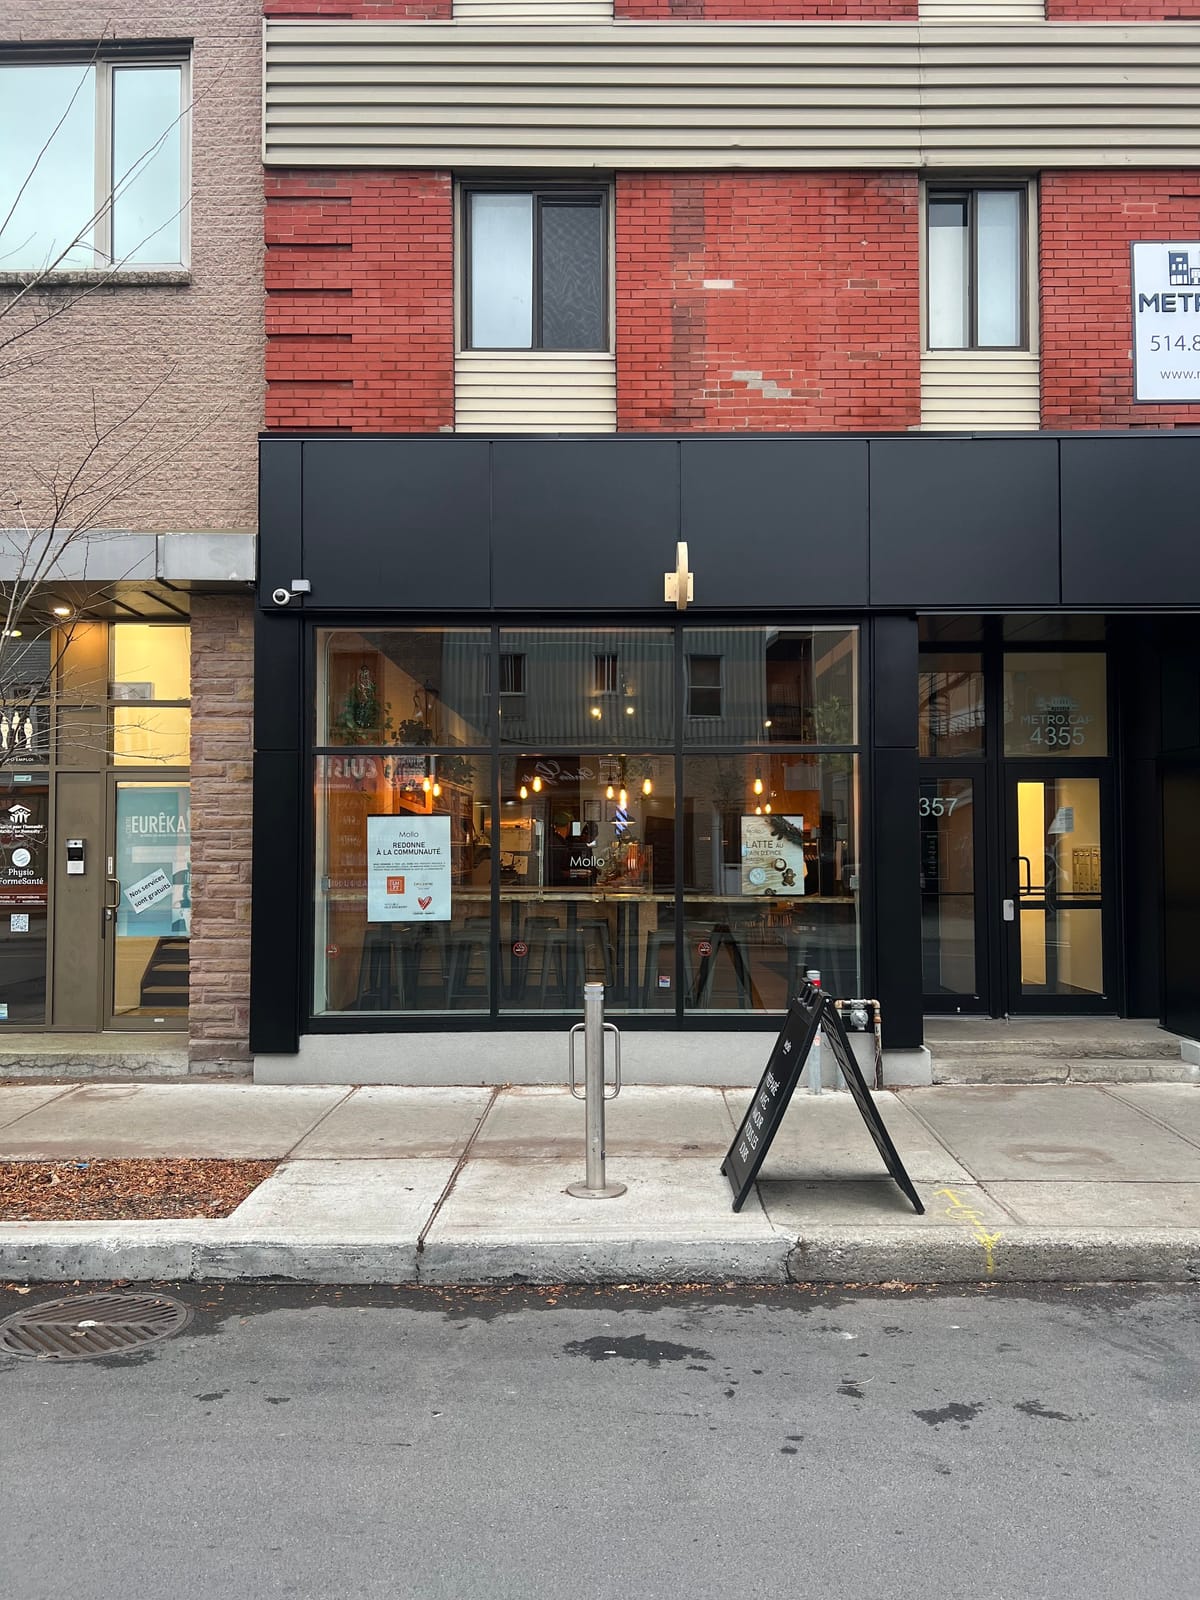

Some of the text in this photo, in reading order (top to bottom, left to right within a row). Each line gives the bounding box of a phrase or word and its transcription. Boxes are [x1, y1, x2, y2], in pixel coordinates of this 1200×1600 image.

[1030, 726, 1085, 745] 4355
[131, 811, 187, 834] EURÊKA
[392, 841, 426, 849] REDONNE
[745, 839, 774, 849] LATTE
[376, 847, 441, 856] À LA COMMUNAUTÉ
[569, 855, 605, 867] Mollo
[8, 868, 35, 878] Physio
[129, 875, 165, 899] Nos services
[134, 883, 171, 908] sont gratuits
